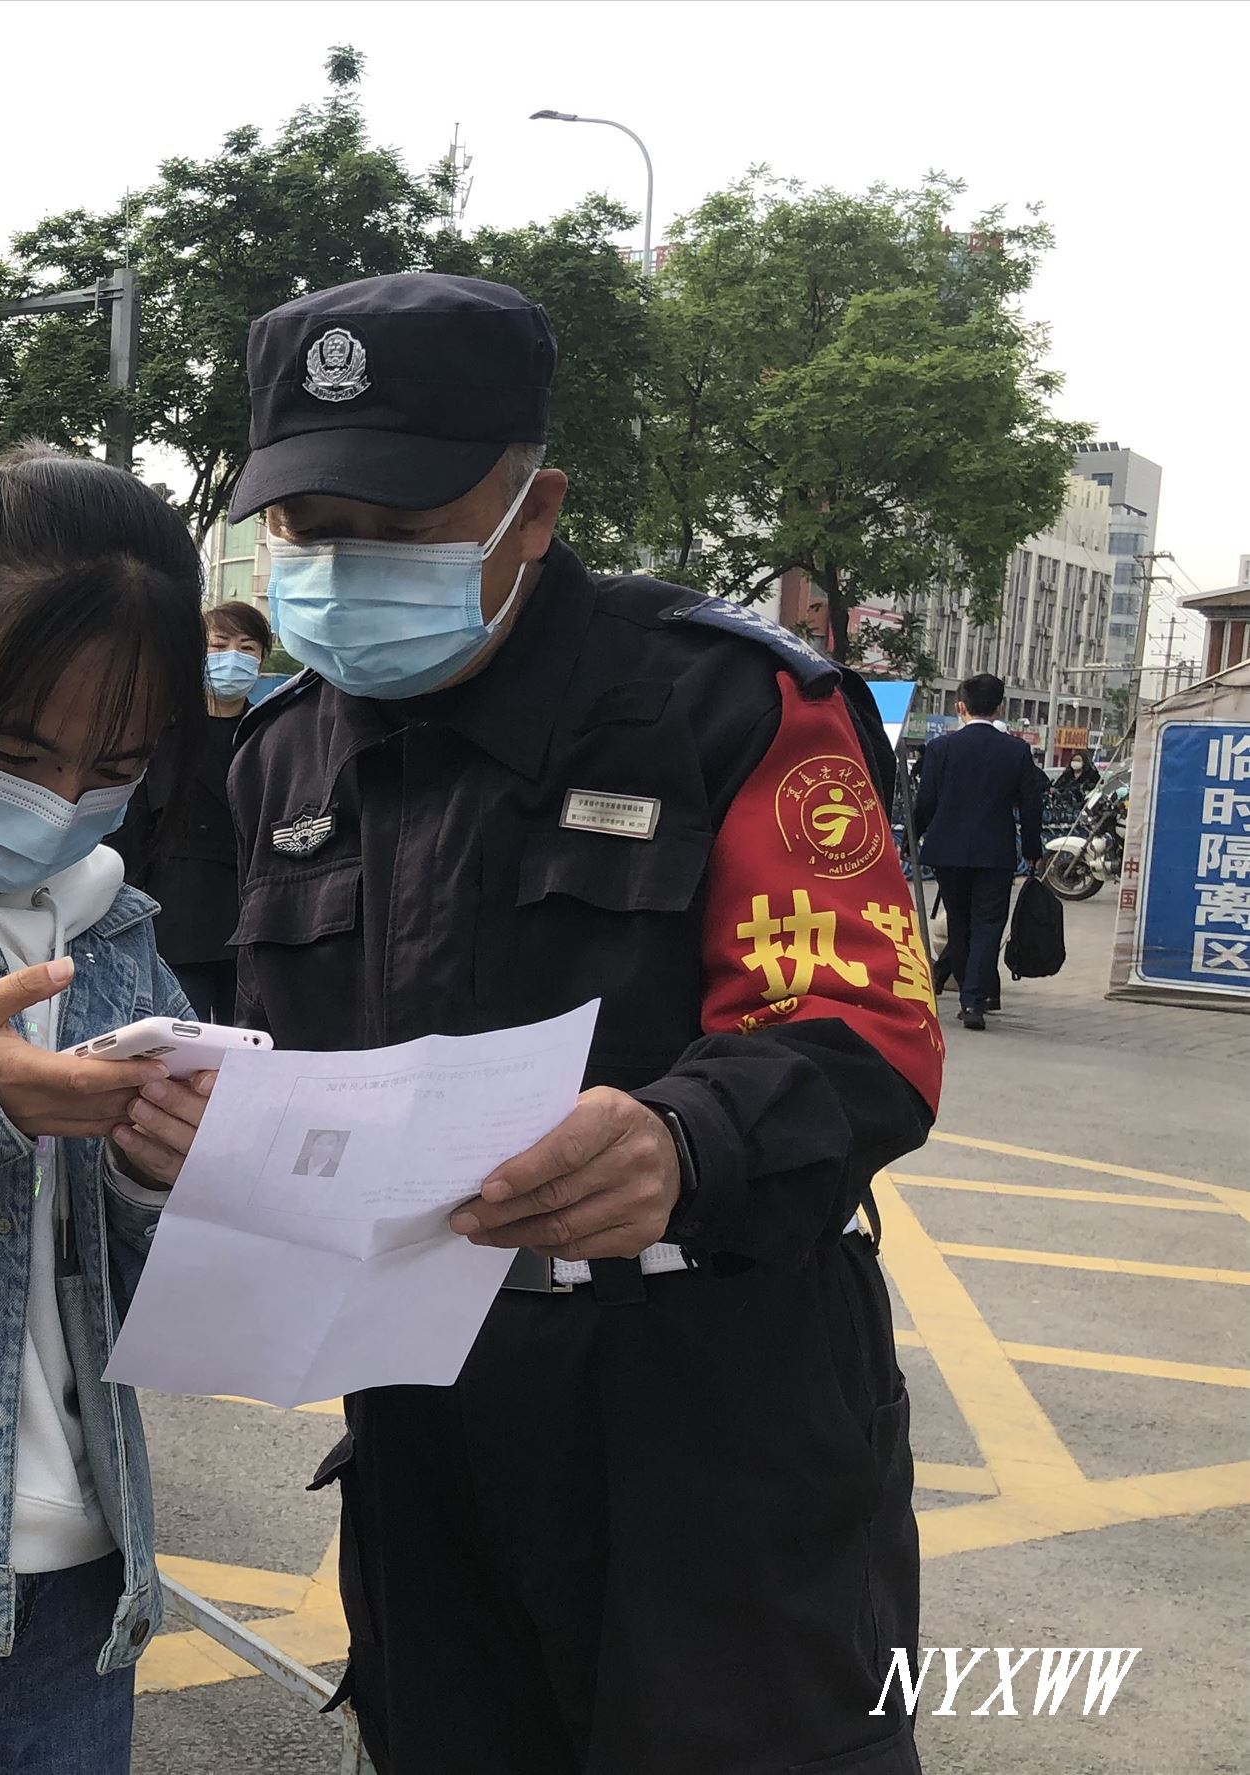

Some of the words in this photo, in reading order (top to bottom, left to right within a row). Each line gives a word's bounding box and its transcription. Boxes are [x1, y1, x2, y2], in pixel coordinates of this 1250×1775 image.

[845, 832, 881, 872] University
[1120, 857, 1139, 910] 中国
[1191, 735, 1250, 979] 临时隔离区
[737, 889, 937, 1018] 执勤
